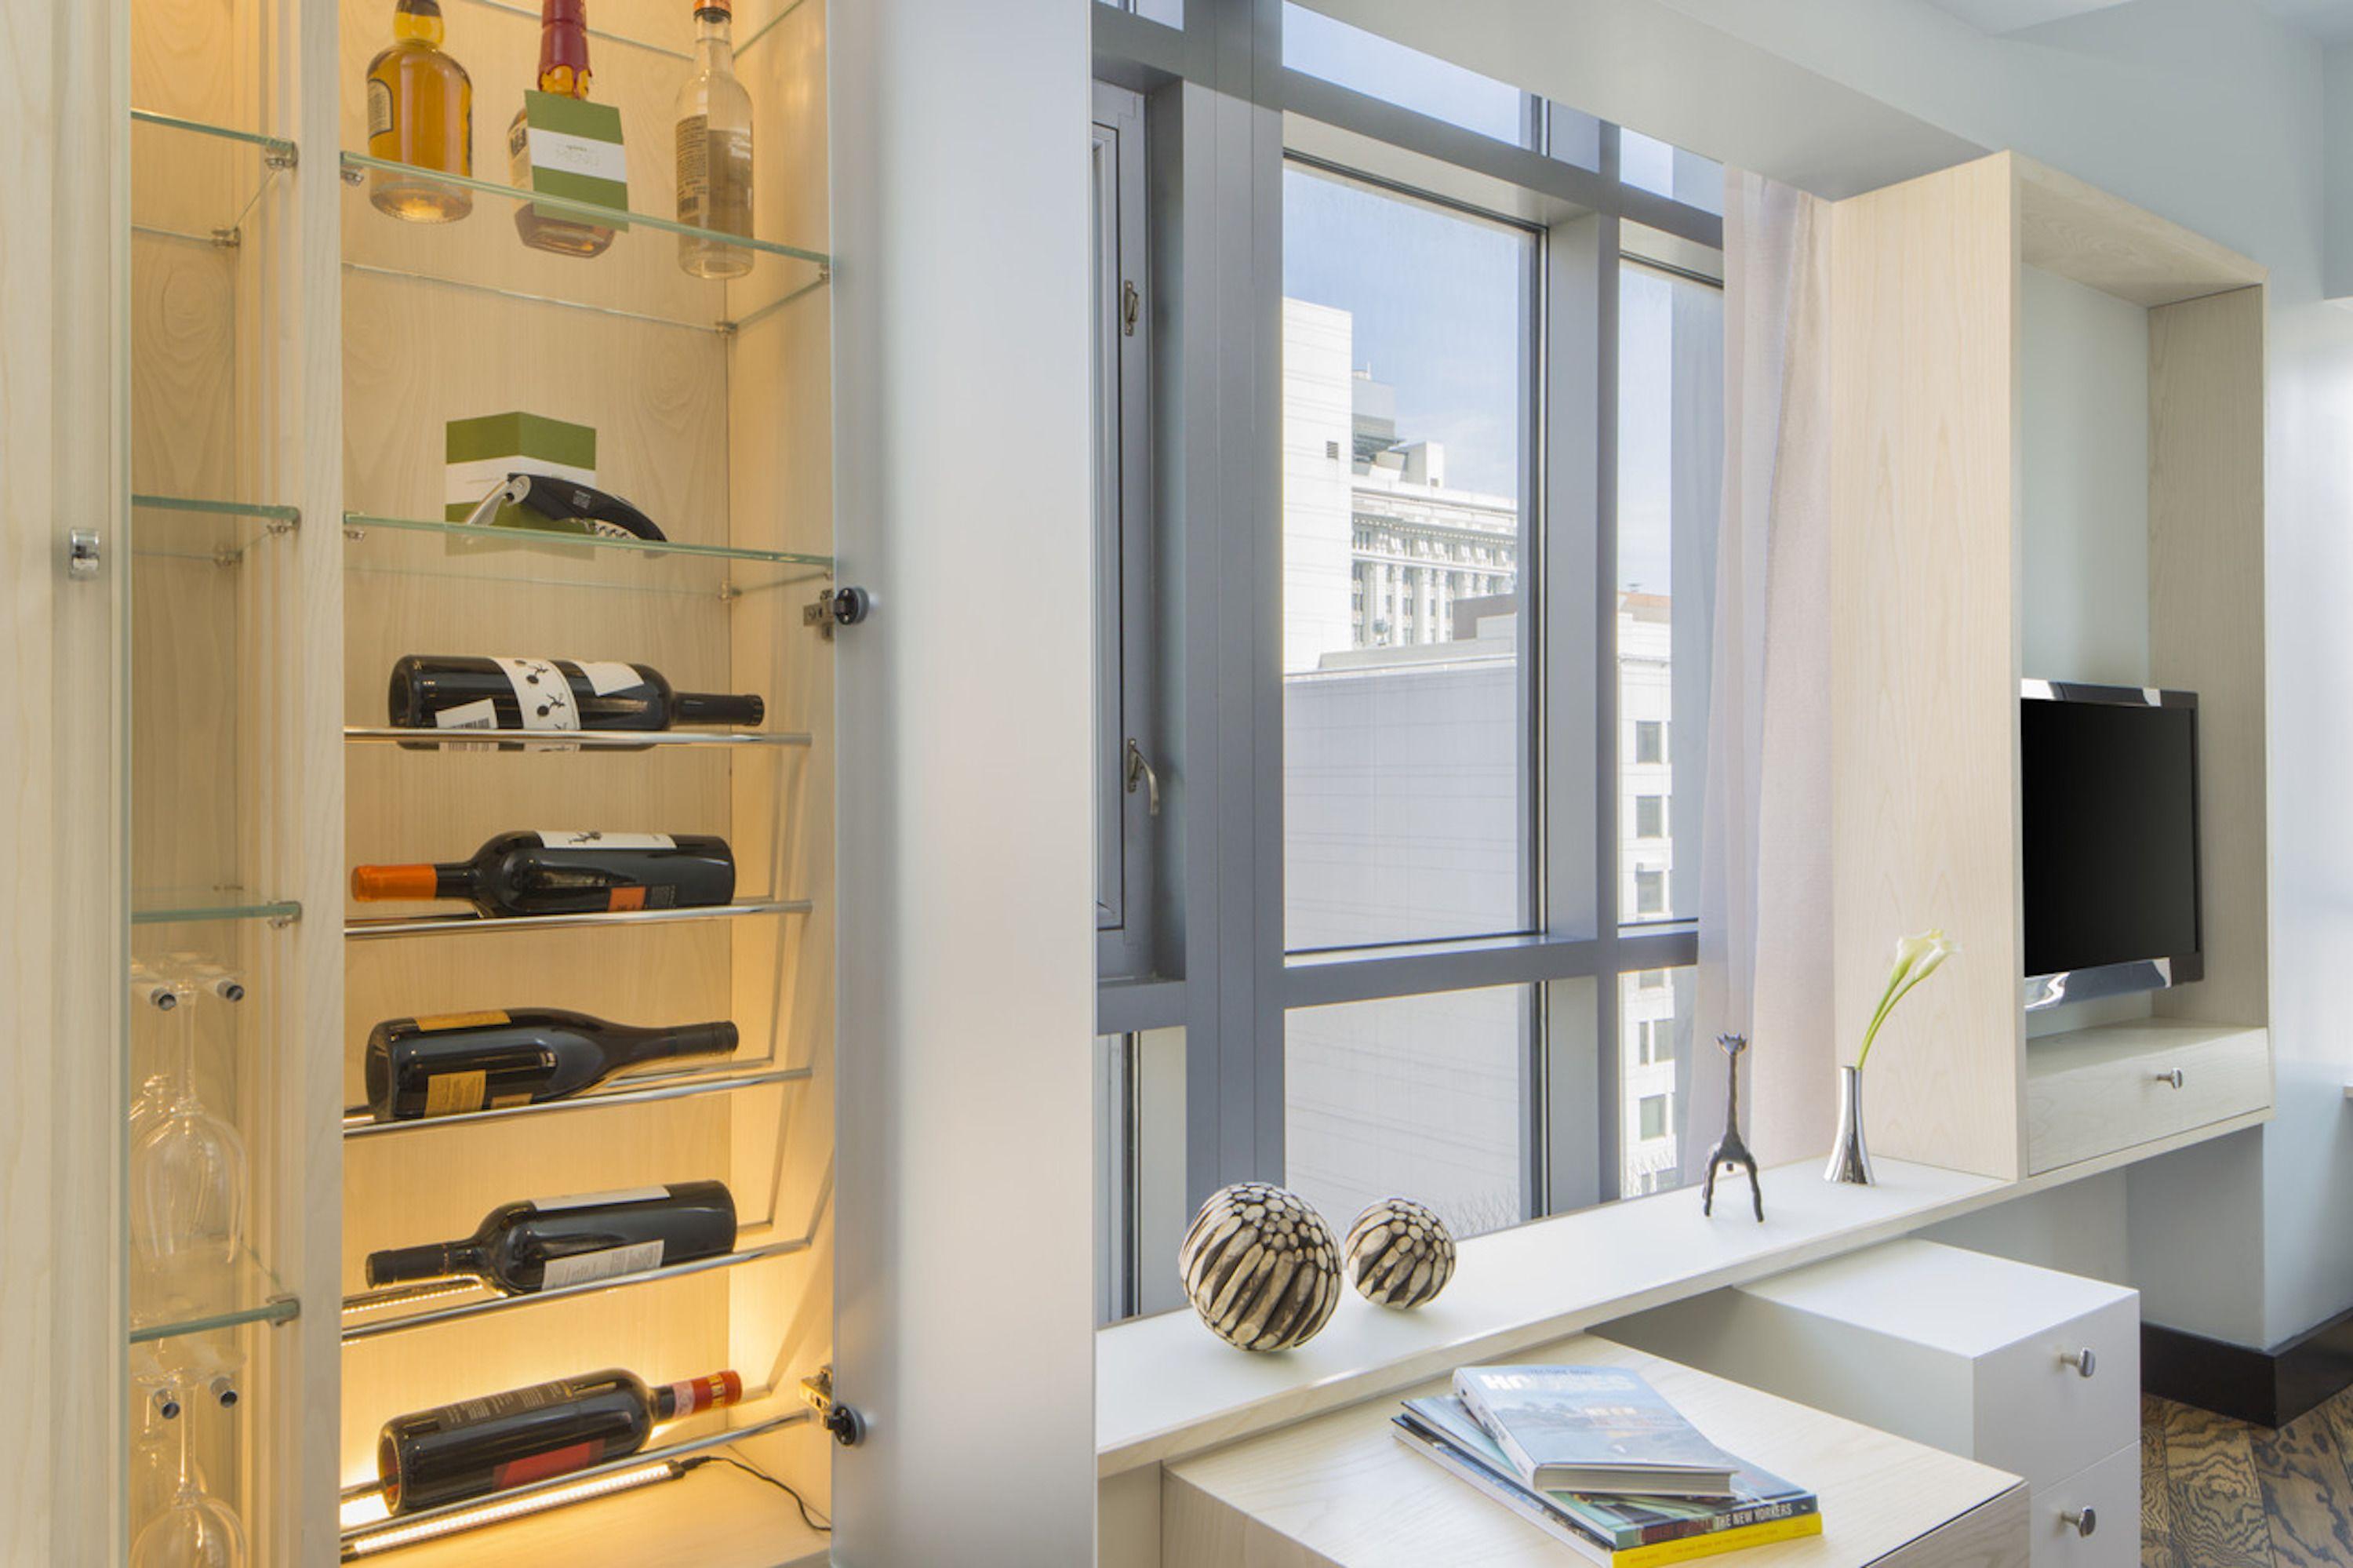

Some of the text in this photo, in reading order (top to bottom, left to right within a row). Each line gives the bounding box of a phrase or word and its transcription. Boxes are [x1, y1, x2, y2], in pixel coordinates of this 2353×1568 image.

[1715, 1513, 1732, 1530] THE
[1733, 1509, 1753, 1525] NEW
[1755, 1503, 1793, 1521] YORKERS
